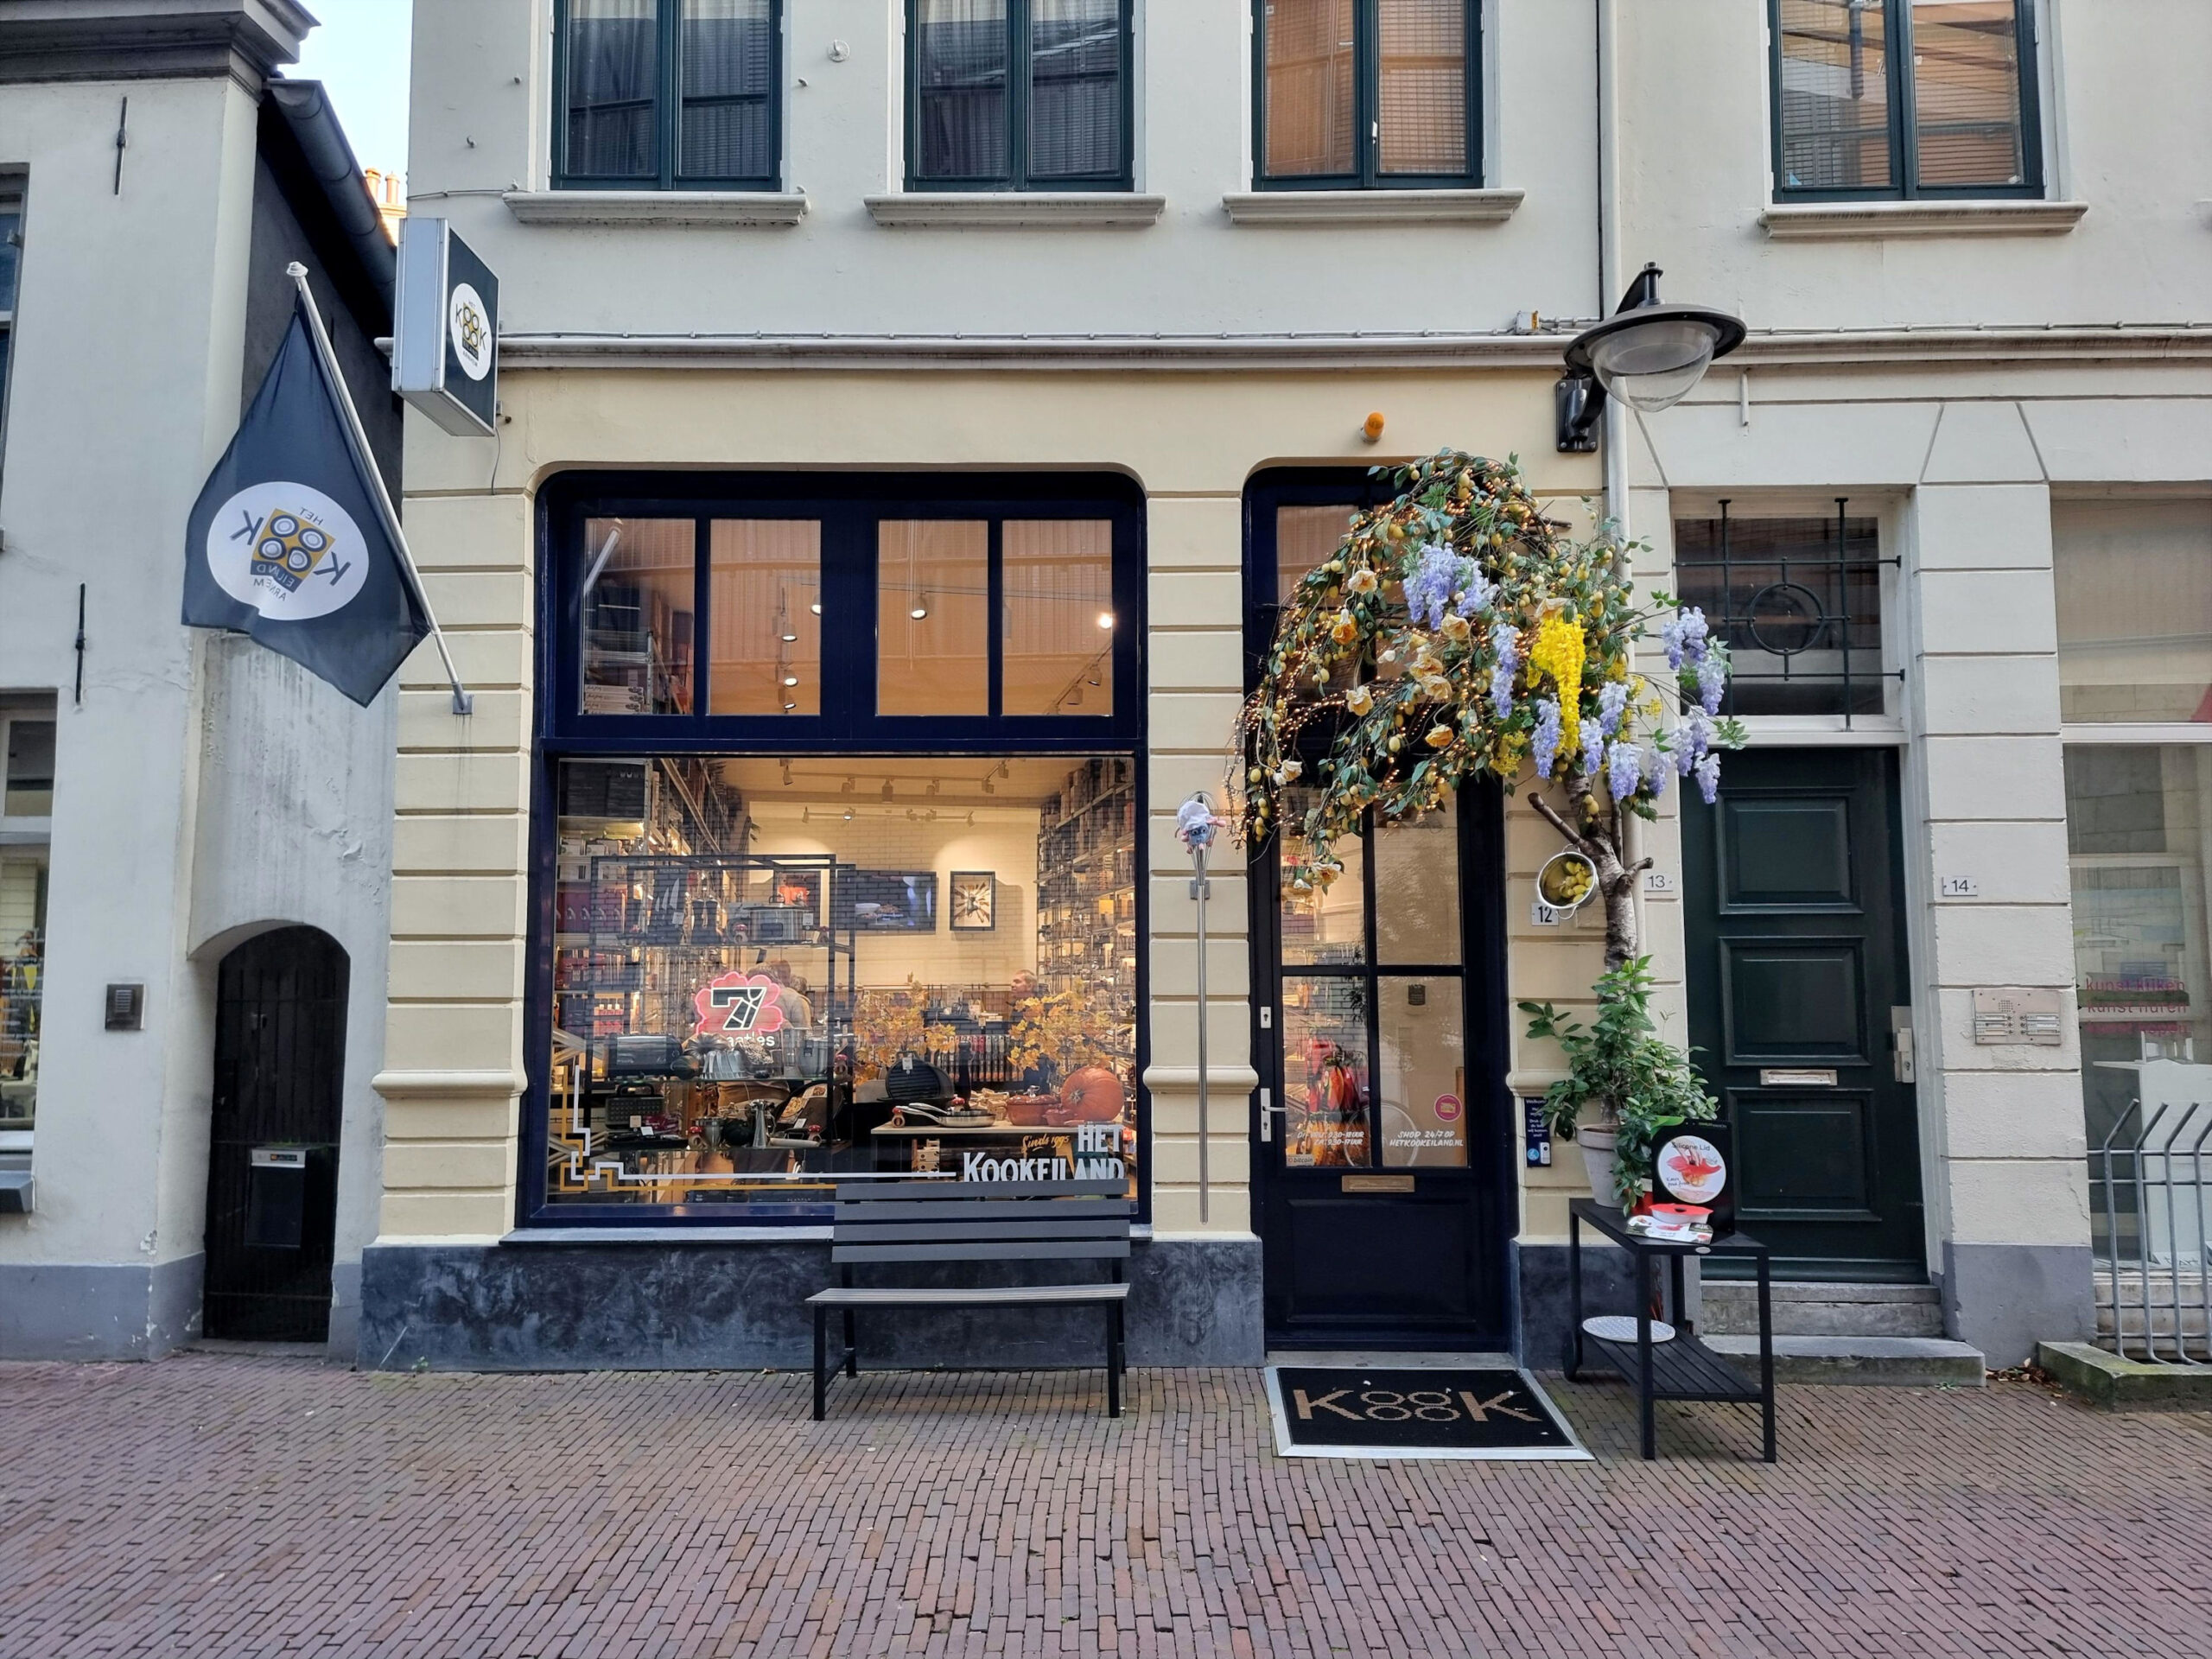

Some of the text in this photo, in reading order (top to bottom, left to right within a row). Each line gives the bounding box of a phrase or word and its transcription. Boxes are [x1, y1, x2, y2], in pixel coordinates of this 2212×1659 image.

[1648, 875, 1665, 887] 13
[1951, 880, 1969, 892] 14
[1538, 906, 1553, 923] 12
[2086, 978, 2133, 991] kunst
[711, 986, 767, 1030] 7
[2088, 1000, 2186, 1013] kunst huren
[1078, 1124, 1123, 1152] HET
[1424, 1129, 1444, 1139] 24/7
[1021, 1134, 1050, 1151] Sinds
[1389, 1139, 1464, 1147] HETKOOKEILAND.NL
